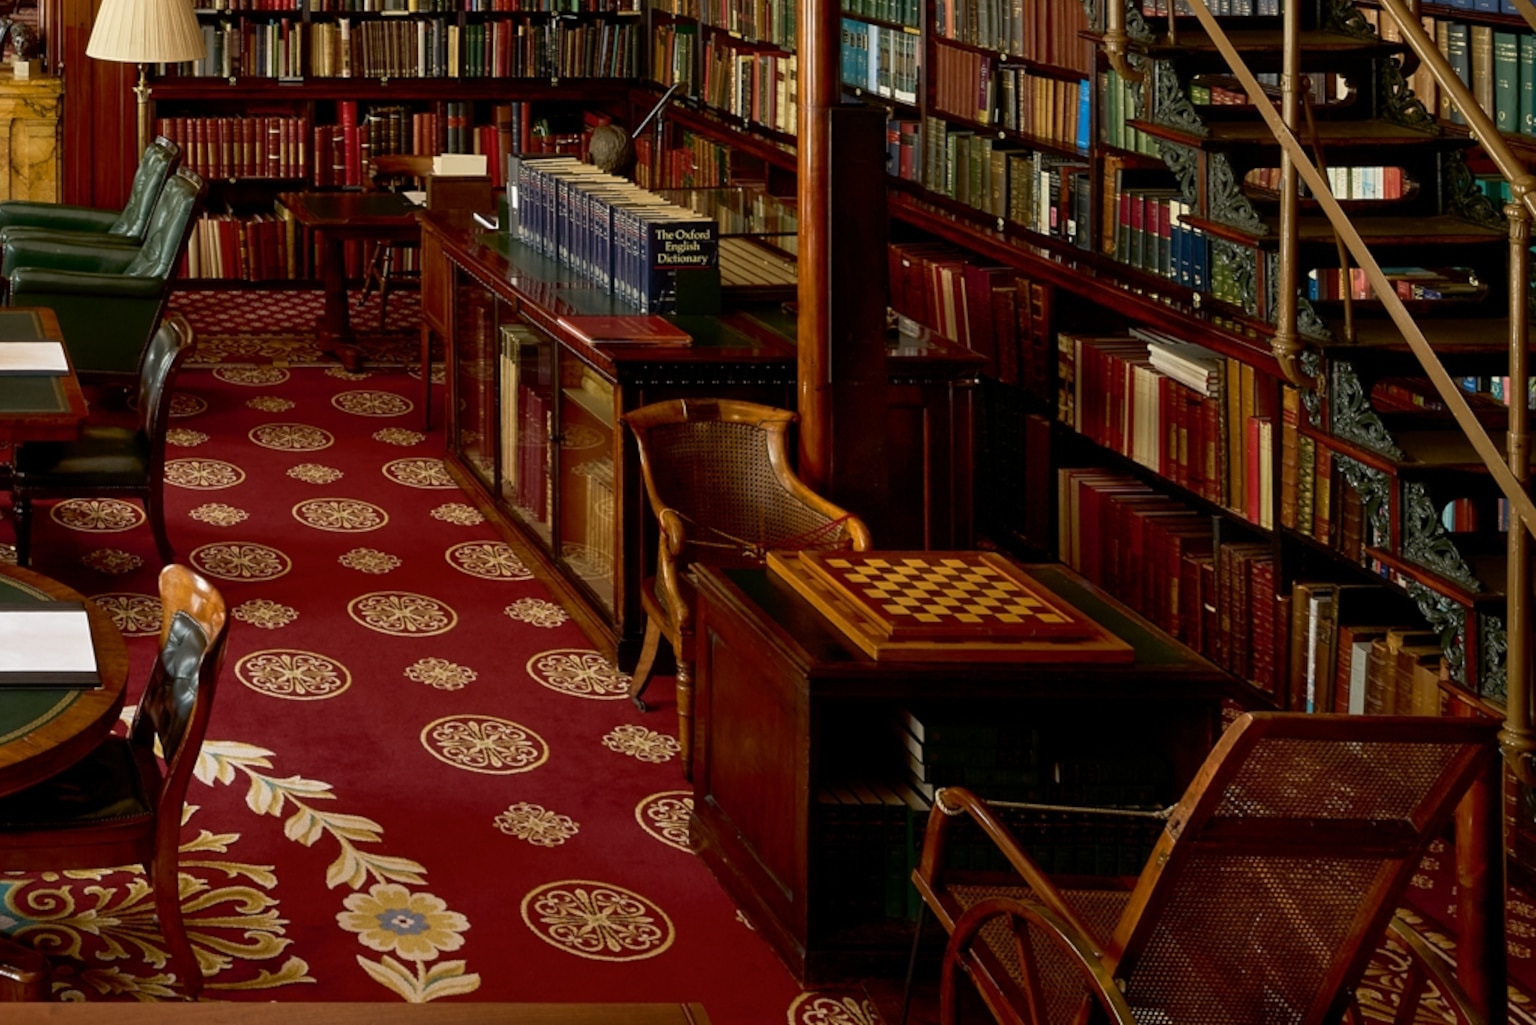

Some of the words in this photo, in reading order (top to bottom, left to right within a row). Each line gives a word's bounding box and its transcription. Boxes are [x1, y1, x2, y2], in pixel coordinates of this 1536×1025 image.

[655, 229, 674, 240] The
[675, 228, 711, 240] Oxford
[665, 240, 701, 254] English
[657, 253, 709, 266] Dictionary
